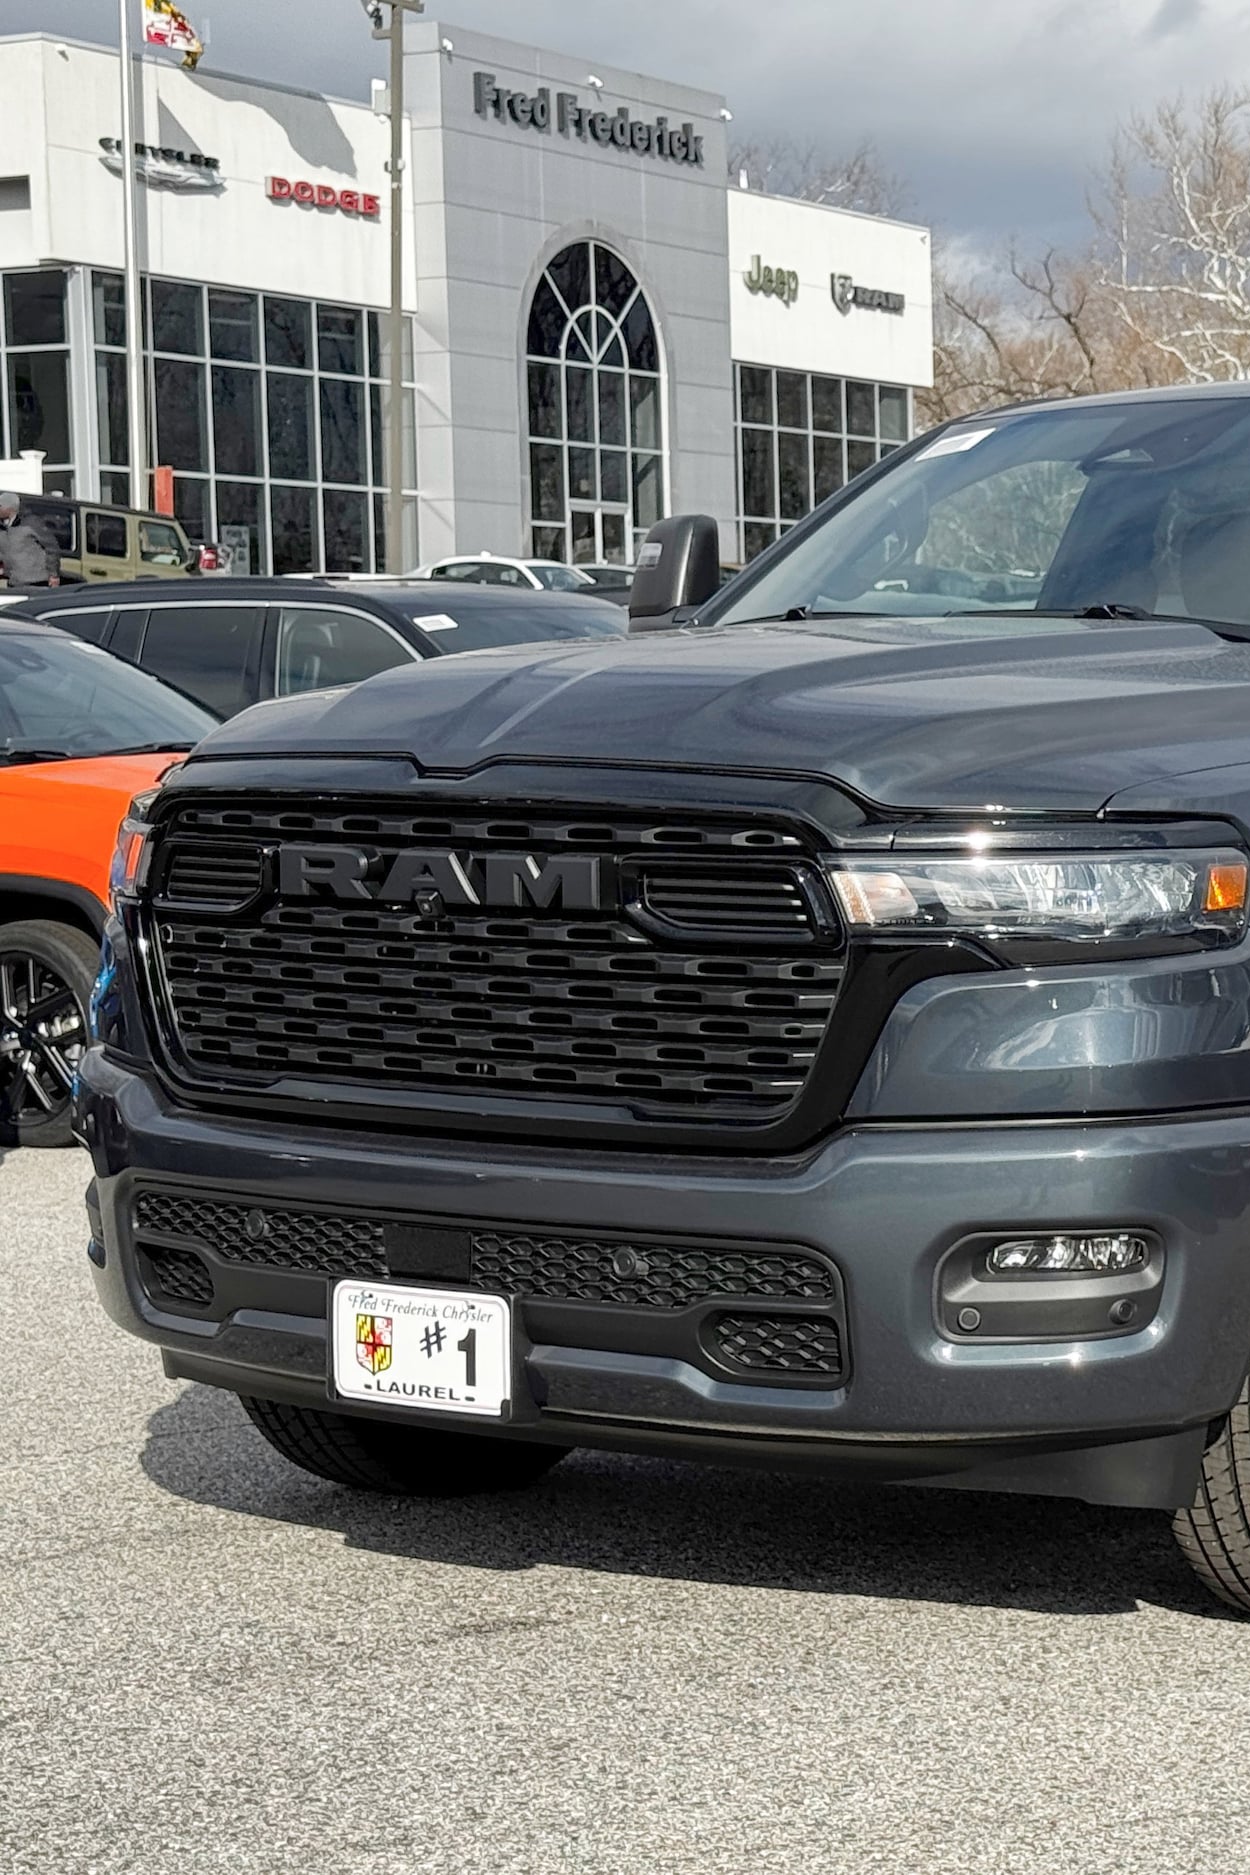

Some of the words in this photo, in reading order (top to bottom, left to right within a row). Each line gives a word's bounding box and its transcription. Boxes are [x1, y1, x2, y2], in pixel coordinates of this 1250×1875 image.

[473, 71, 550, 135] Fred
[556, 91, 704, 165] Frederick
[265, 176, 381, 217] DODGE
[743, 254, 799, 308] Jeep
[279, 843, 601, 910] RAM
[348, 1293, 378, 1311] Fred
[381, 1299, 439, 1318] Frederick
[442, 1304, 493, 1324] Chrysler
